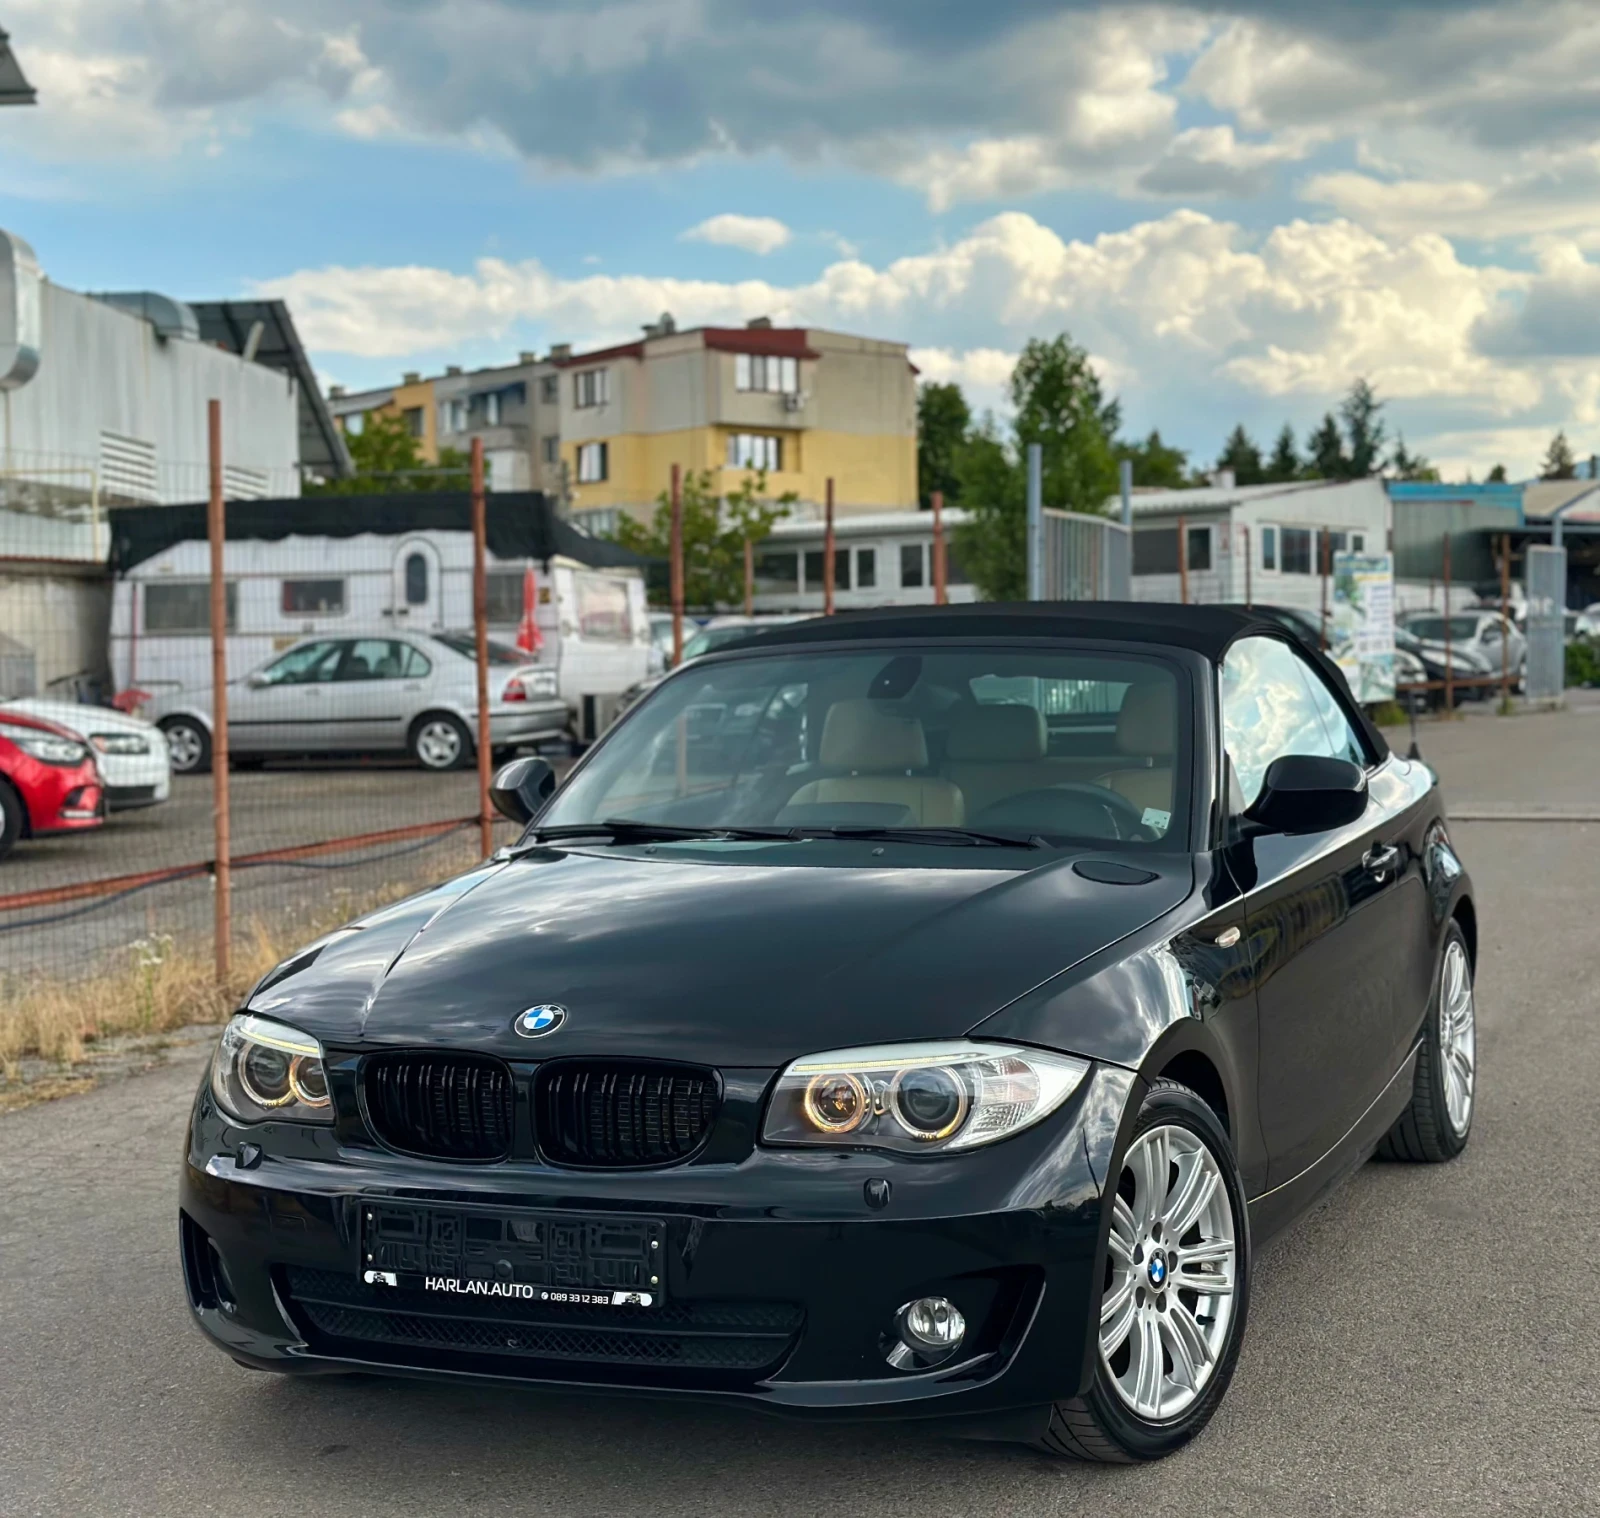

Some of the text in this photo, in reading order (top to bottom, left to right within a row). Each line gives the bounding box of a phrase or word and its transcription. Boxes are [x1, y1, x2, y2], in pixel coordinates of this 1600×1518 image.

[425, 1276, 609, 1305] HARLAN.AUTO 089 33 12 383
